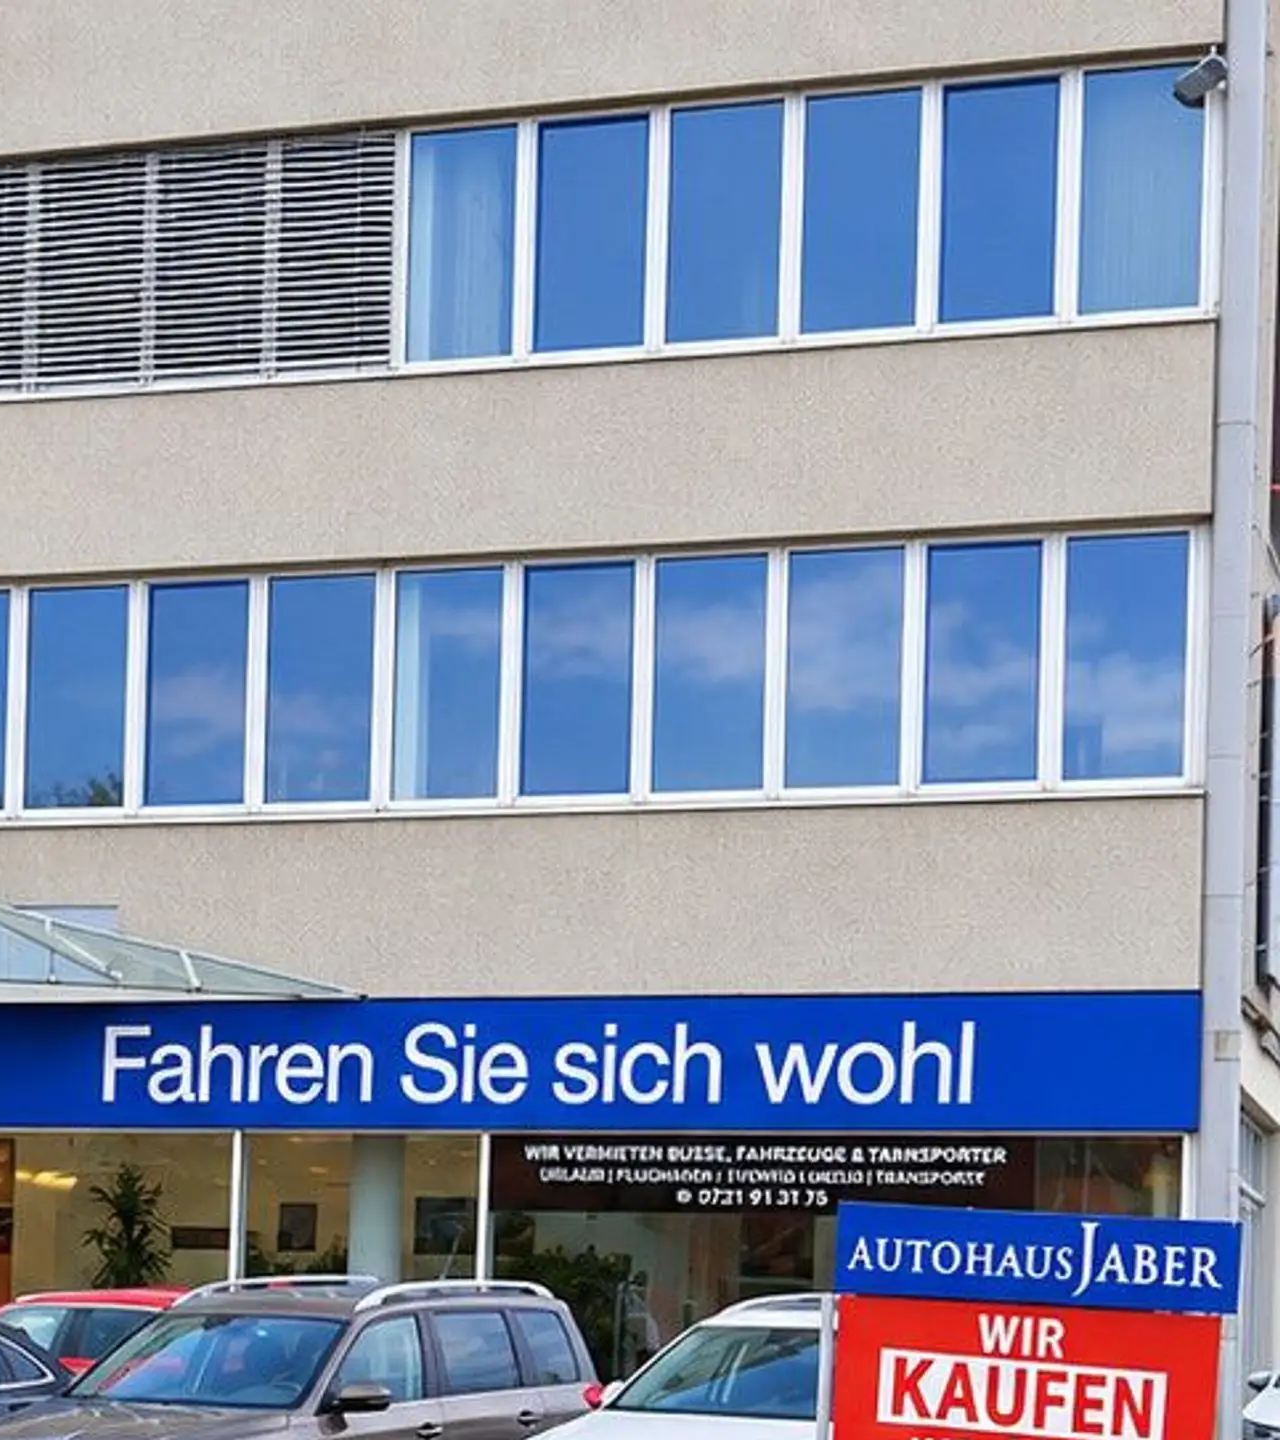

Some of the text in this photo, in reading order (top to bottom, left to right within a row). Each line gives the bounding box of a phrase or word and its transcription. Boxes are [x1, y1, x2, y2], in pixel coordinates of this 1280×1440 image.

[102, 1021, 975, 1105] Fahren Sie sich wohl
[847, 1221, 1223, 1297] AUTOHAUS JABER
[978, 1313, 1066, 1359] WIR
[891, 1356, 1155, 1439] KAUFEN
